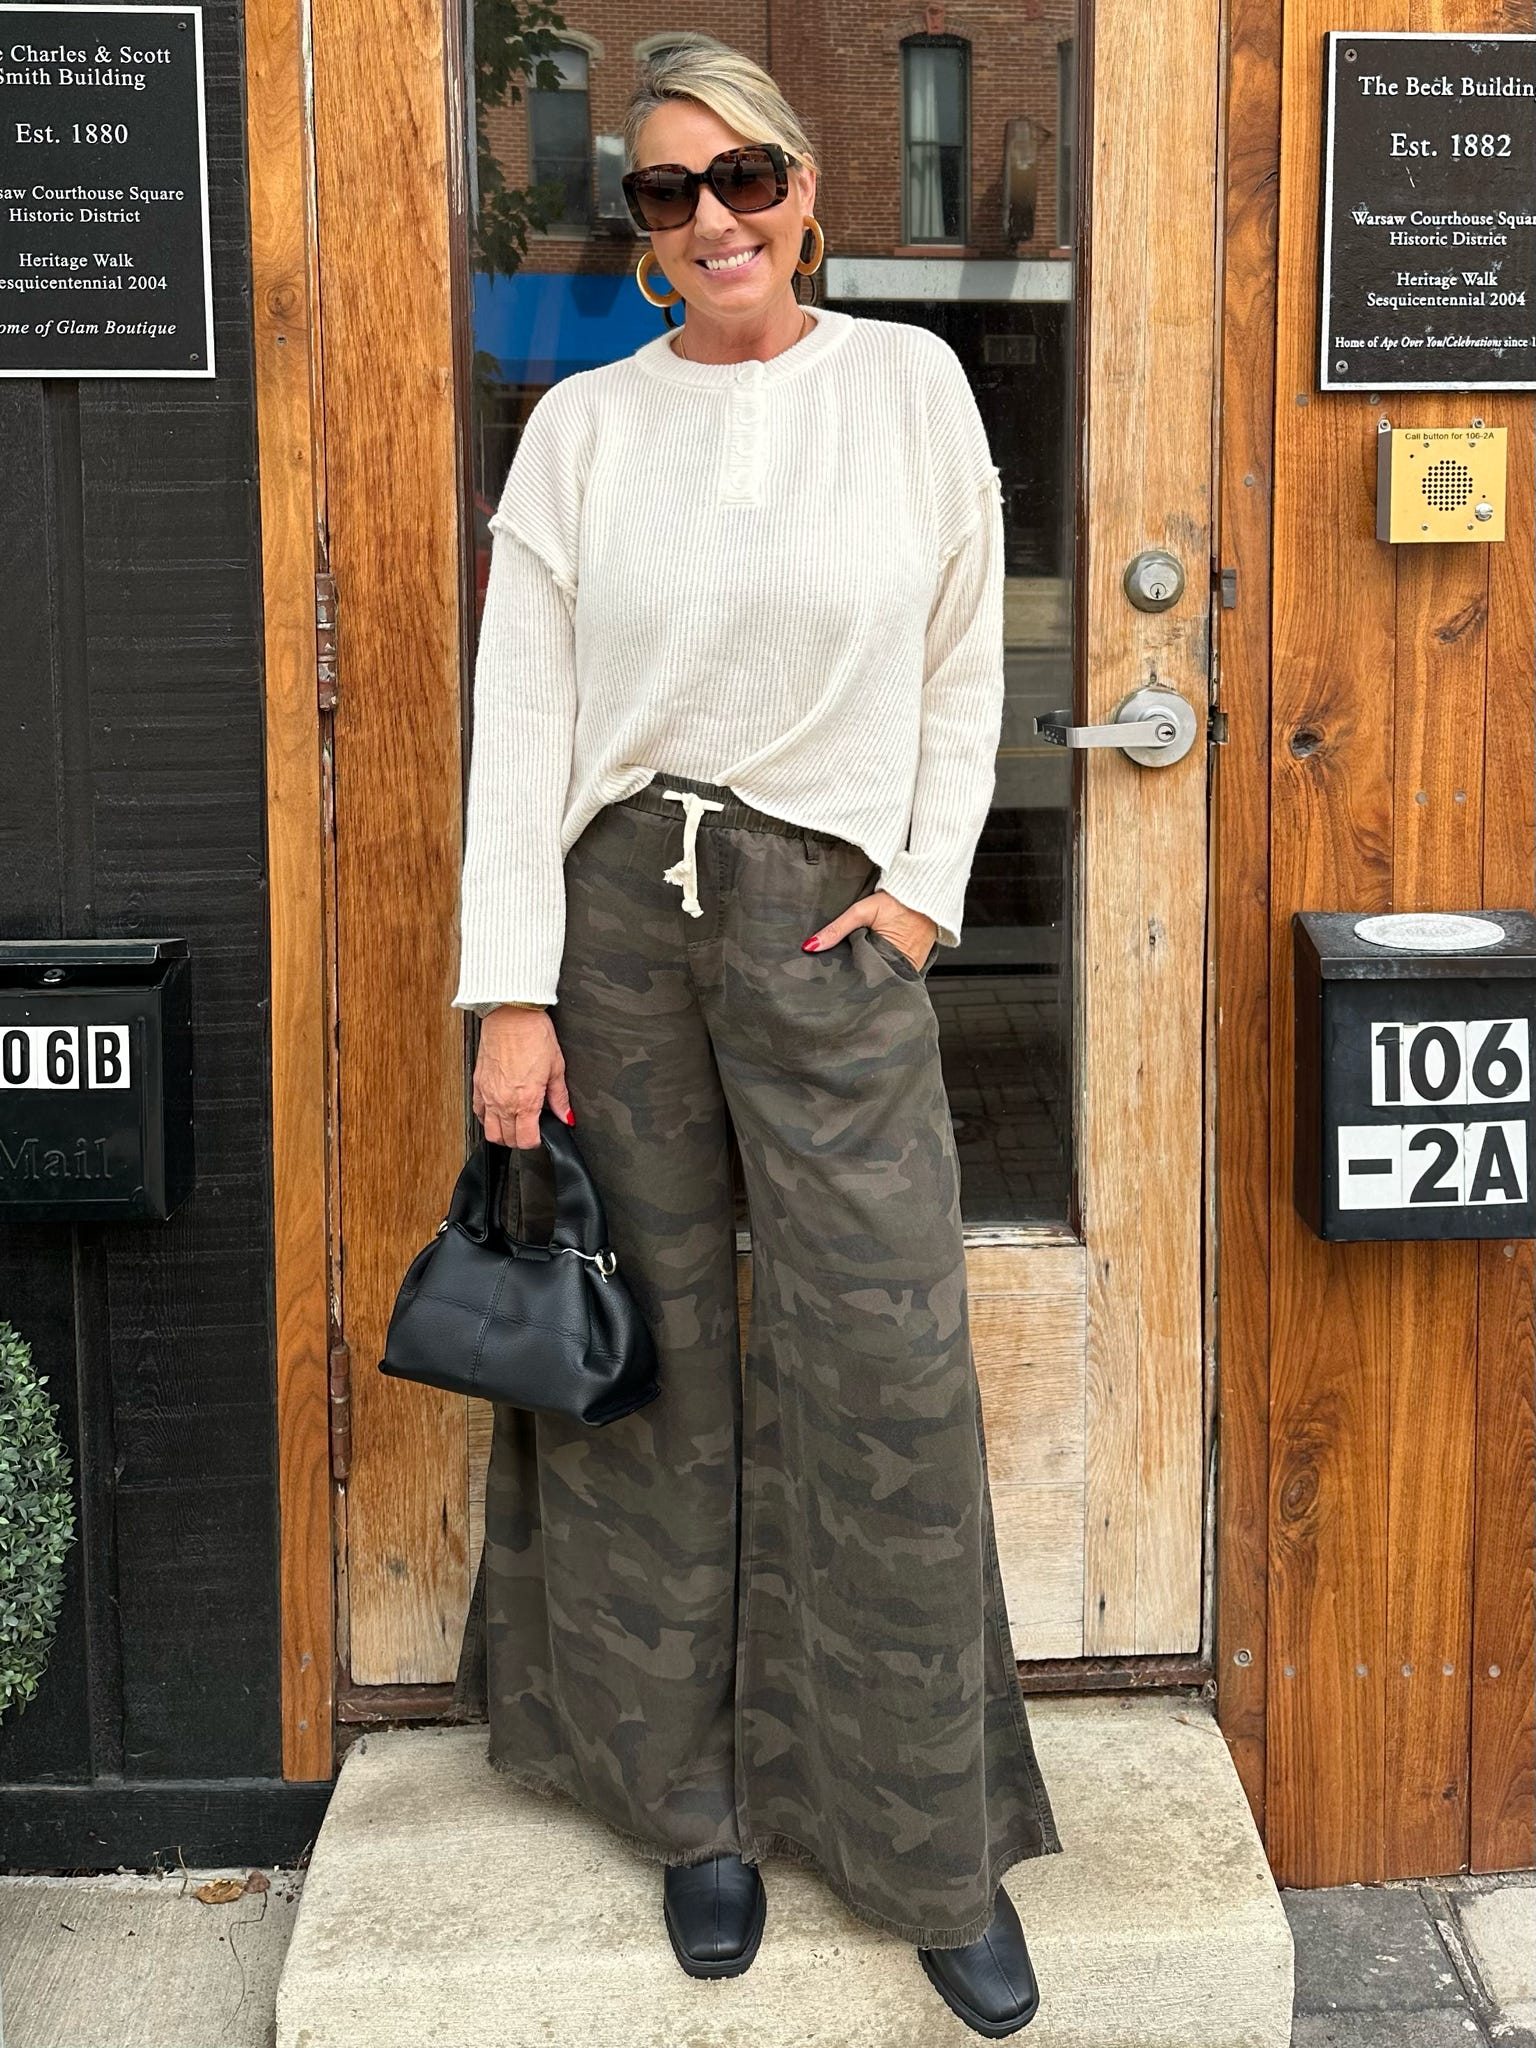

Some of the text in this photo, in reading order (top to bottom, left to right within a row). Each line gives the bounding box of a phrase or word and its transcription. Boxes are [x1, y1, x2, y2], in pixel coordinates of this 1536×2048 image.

[10, 44, 87, 63] Charles
[94, 46, 112, 63] &
[119, 46, 171, 64] Scott
[58, 68, 146, 91] Building
[1358, 76, 1536, 103] The Beck Buildin
[15, 123, 128, 144] Est. 1880
[1389, 132, 1512, 158] Est. 1882
[31, 185, 124, 200] Courthouse
[129, 186, 184, 204] Square
[9, 207, 141, 223] Historic District
[1351, 210, 1407, 226] Warsaw
[1410, 210, 1494, 226] Courthouse
[1389, 231, 1508, 246] Historic District
[19, 252, 134, 271] Heritage Walk
[128, 276, 168, 290] 2004
[1396, 271, 1498, 288] Heritage Walk
[1366, 291, 1526, 311] Sesquicentennial 2004
[34, 320, 54, 338] of
[56, 320, 99, 335] Glam
[104, 320, 177, 338] Boutique
[1335, 336, 1365, 348] Home
[1367, 336, 1379, 348] of
[1380, 336, 1399, 351] Ape
[1400, 336, 1424, 348] Over
[1426, 335, 1502, 348] You/Celebrations
[1503, 336, 1529, 347] since
[1404, 431, 1495, 440] Call button for 106-2A
[1375, 1022, 1523, 1102] 106
[0, 1137, 112, 1180] Mail
